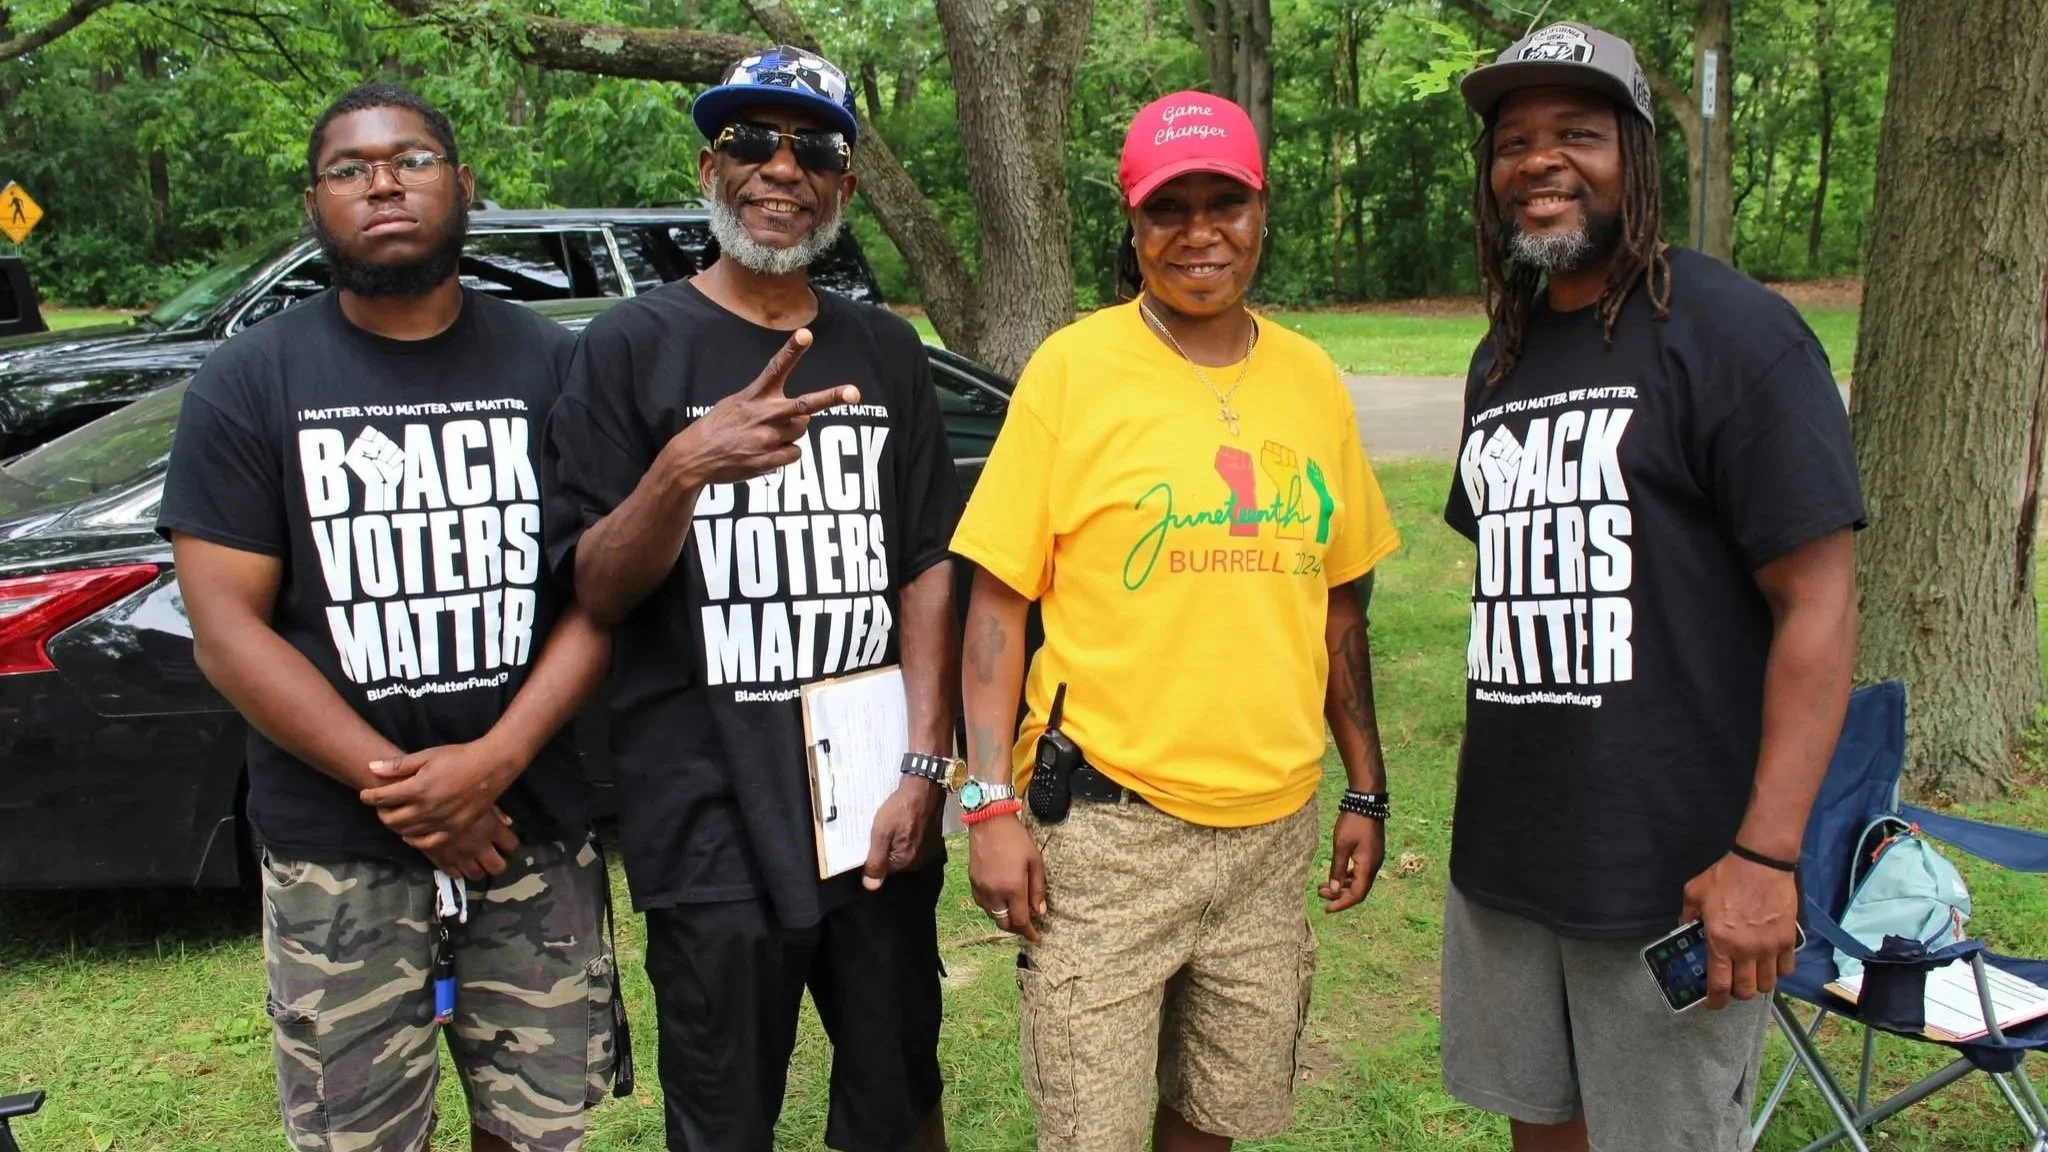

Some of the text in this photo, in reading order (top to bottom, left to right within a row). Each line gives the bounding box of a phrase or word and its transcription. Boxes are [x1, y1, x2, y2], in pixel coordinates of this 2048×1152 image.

[1154, 124, 1228, 145] Changer
[1162, 104, 1214, 126] Game
[298, 398, 528, 422] I MATTER. YOU MATTER. WE MATTER.
[686, 406, 690, 418] I
[829, 404, 849, 416] WE
[1505, 402, 1527, 413] YOU
[1568, 389, 1587, 401] WE
[1586, 386, 1639, 400] MATTER.
[298, 417, 540, 518] BACK
[1460, 408, 1634, 517] BACK
[310, 503, 540, 601] VOTERS
[692, 513, 889, 601] VOTERS
[1169, 550, 1286, 574] BURRELL
[1473, 504, 1633, 597] OTERS
[325, 587, 536, 683] MATTER
[701, 595, 893, 686] MATTER
[1467, 596, 1633, 685] MATTER
